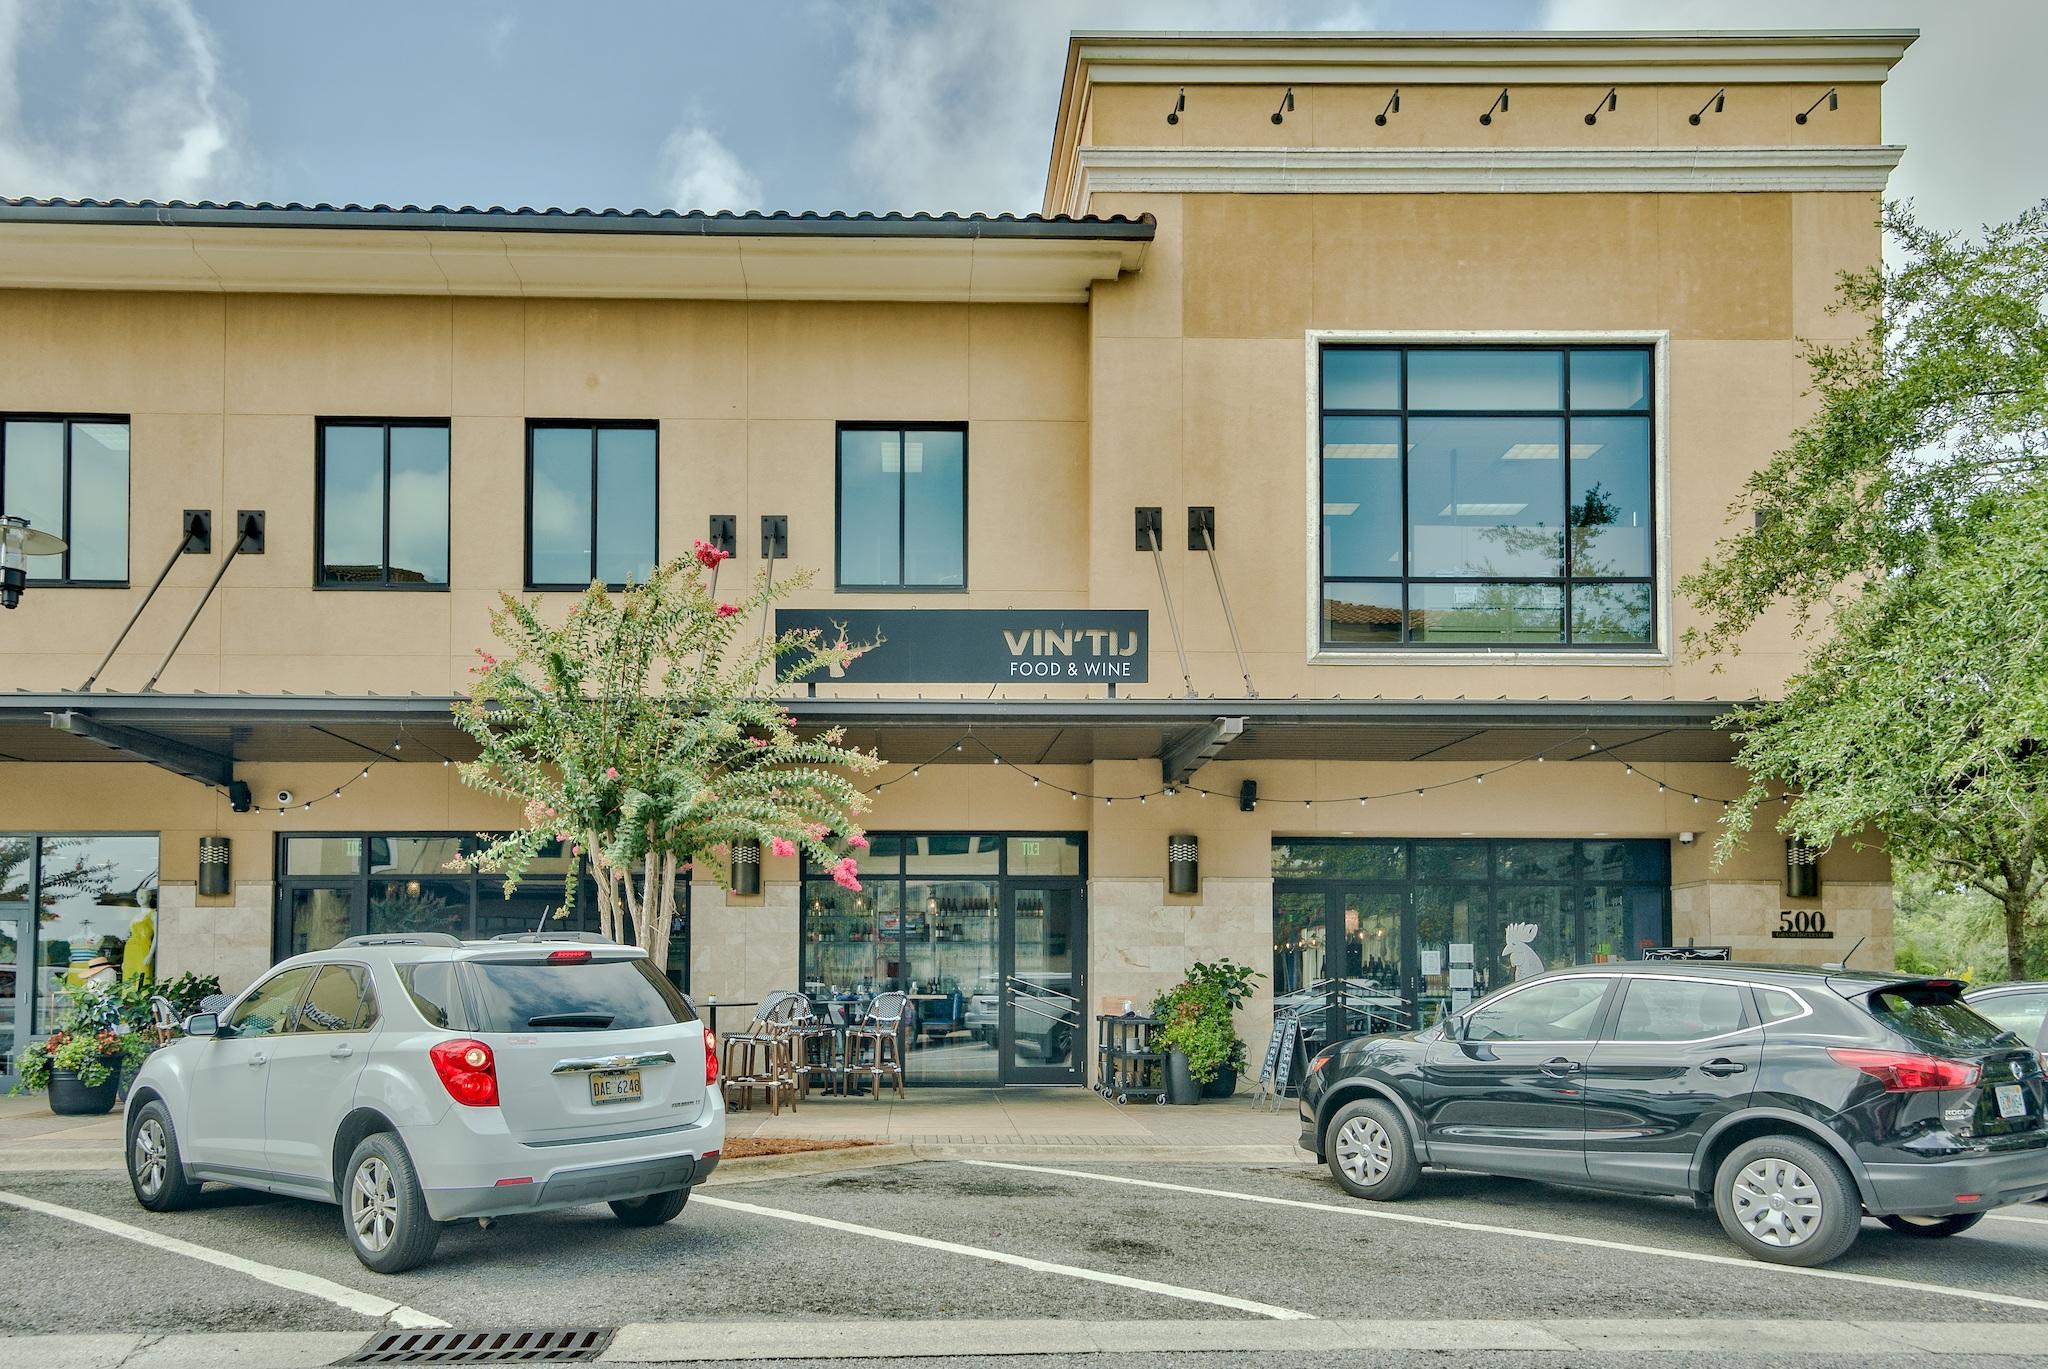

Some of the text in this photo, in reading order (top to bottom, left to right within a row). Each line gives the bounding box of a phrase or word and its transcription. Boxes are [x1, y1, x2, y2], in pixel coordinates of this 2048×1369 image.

[1002, 629, 1138, 656] VIN'TIJ
[1010, 662, 1131, 676] FOOD & WINE
[1779, 910, 1826, 933] 500
[593, 1081, 611, 1097] DAE
[617, 1080, 640, 1093] 6248
